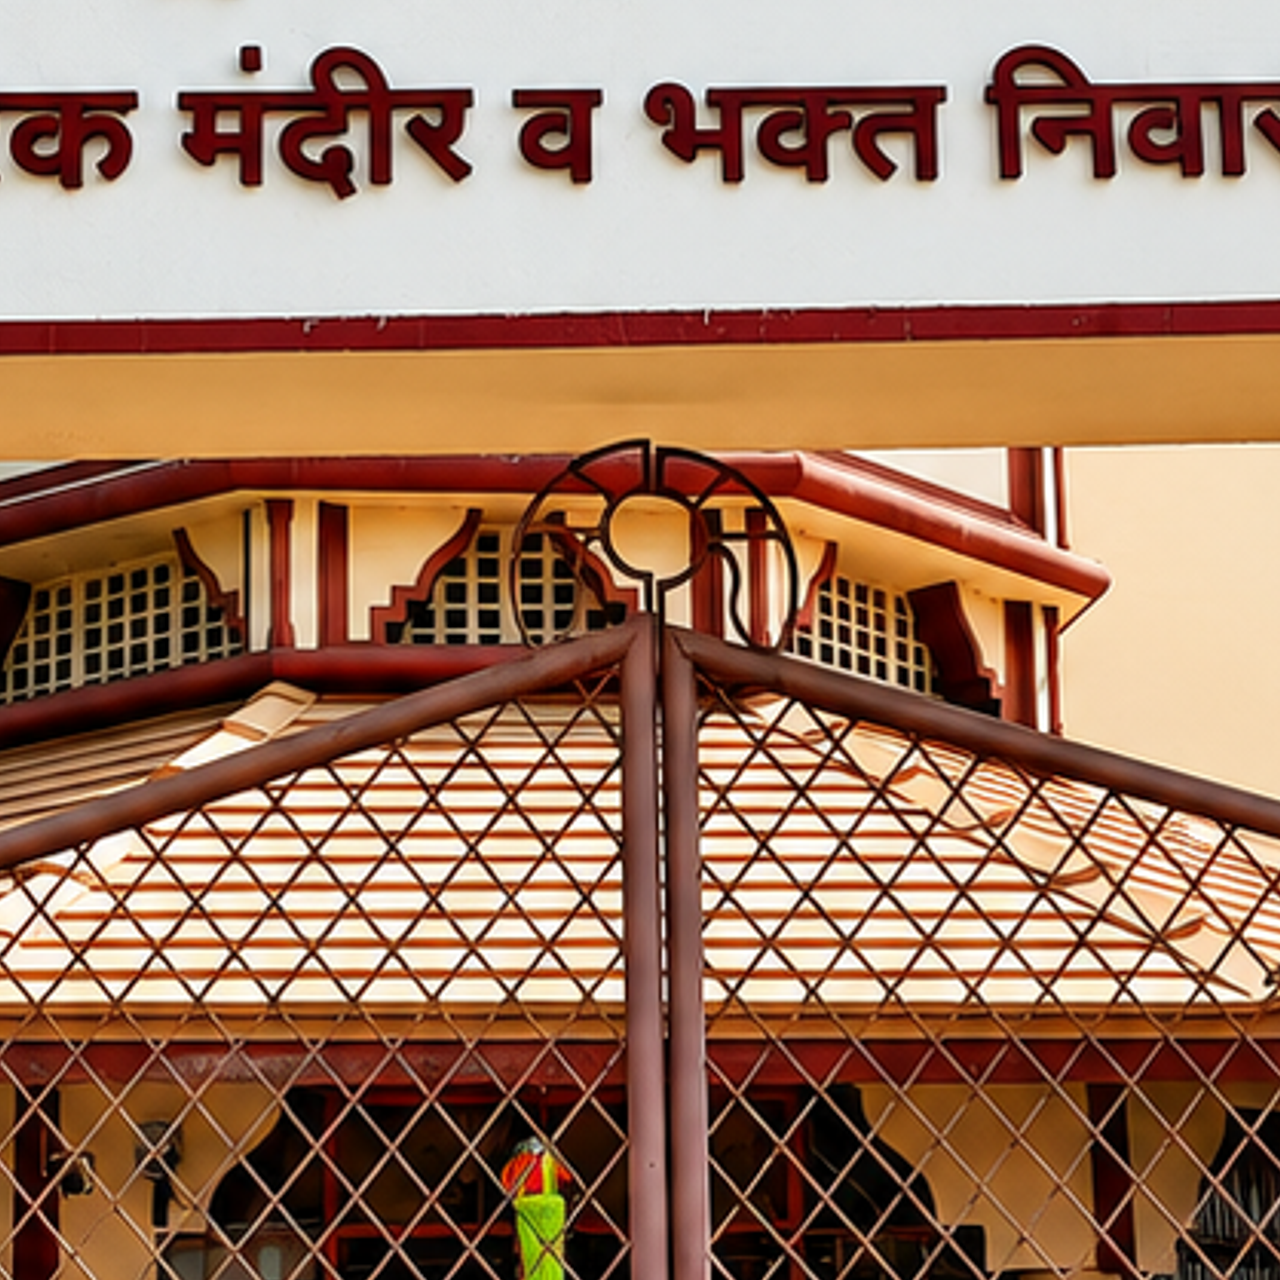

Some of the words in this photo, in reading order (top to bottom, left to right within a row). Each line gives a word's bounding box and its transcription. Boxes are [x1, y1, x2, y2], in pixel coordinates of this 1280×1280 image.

[177, 45, 474, 201] मंदीर
[511, 88, 603, 185] व
[643, 82, 947, 185] भक्त
